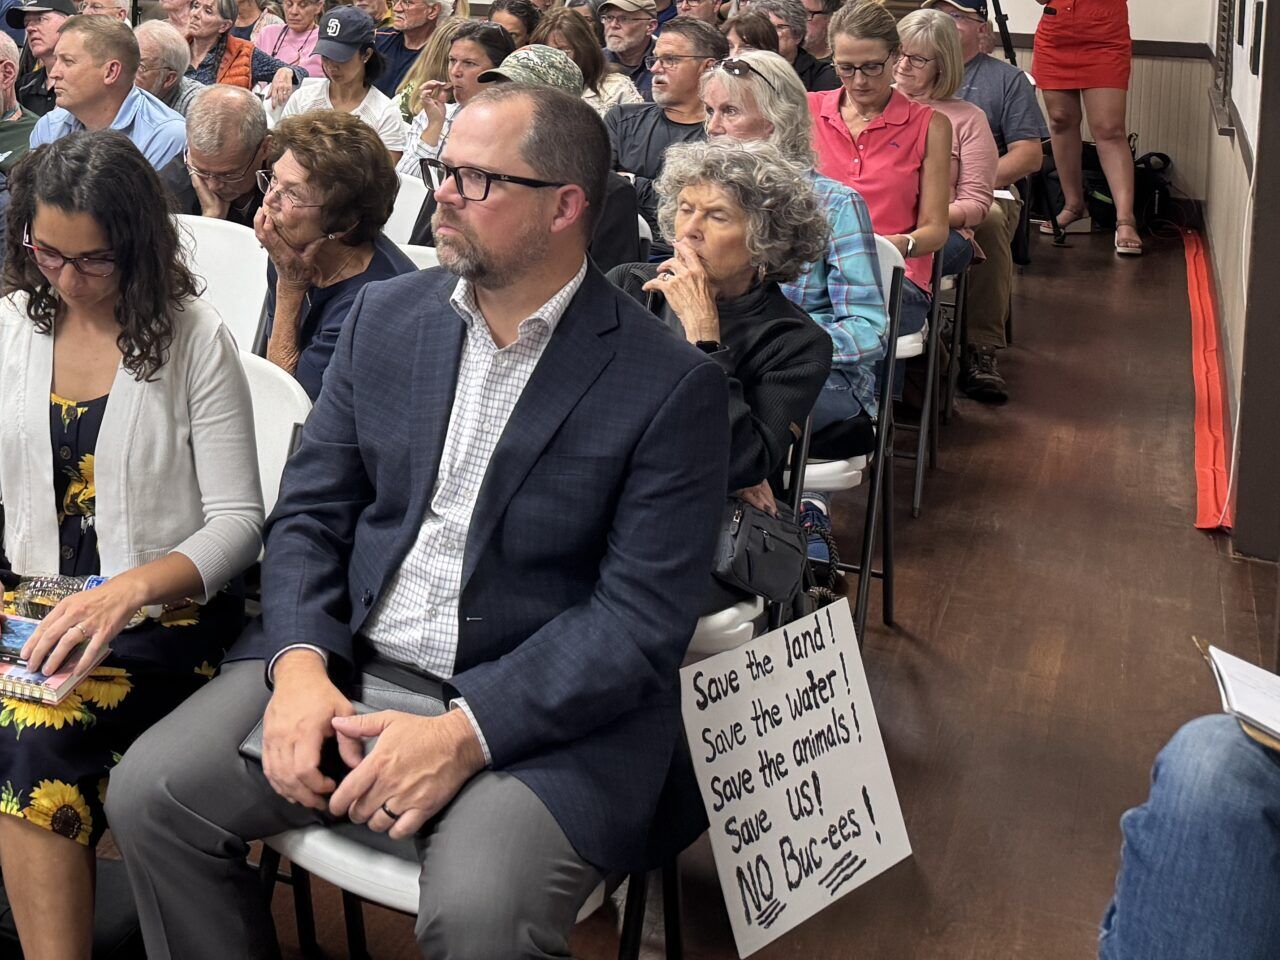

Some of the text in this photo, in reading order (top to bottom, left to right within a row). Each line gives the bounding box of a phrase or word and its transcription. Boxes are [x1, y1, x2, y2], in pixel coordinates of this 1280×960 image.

[692, 607, 836, 711] Save the land!
[701, 651, 851, 763] Save the water!
[710, 768, 755, 813] Save
[758, 749, 789, 788] the
[724, 770, 824, 854] Save us!
[736, 853, 775, 926] NO
